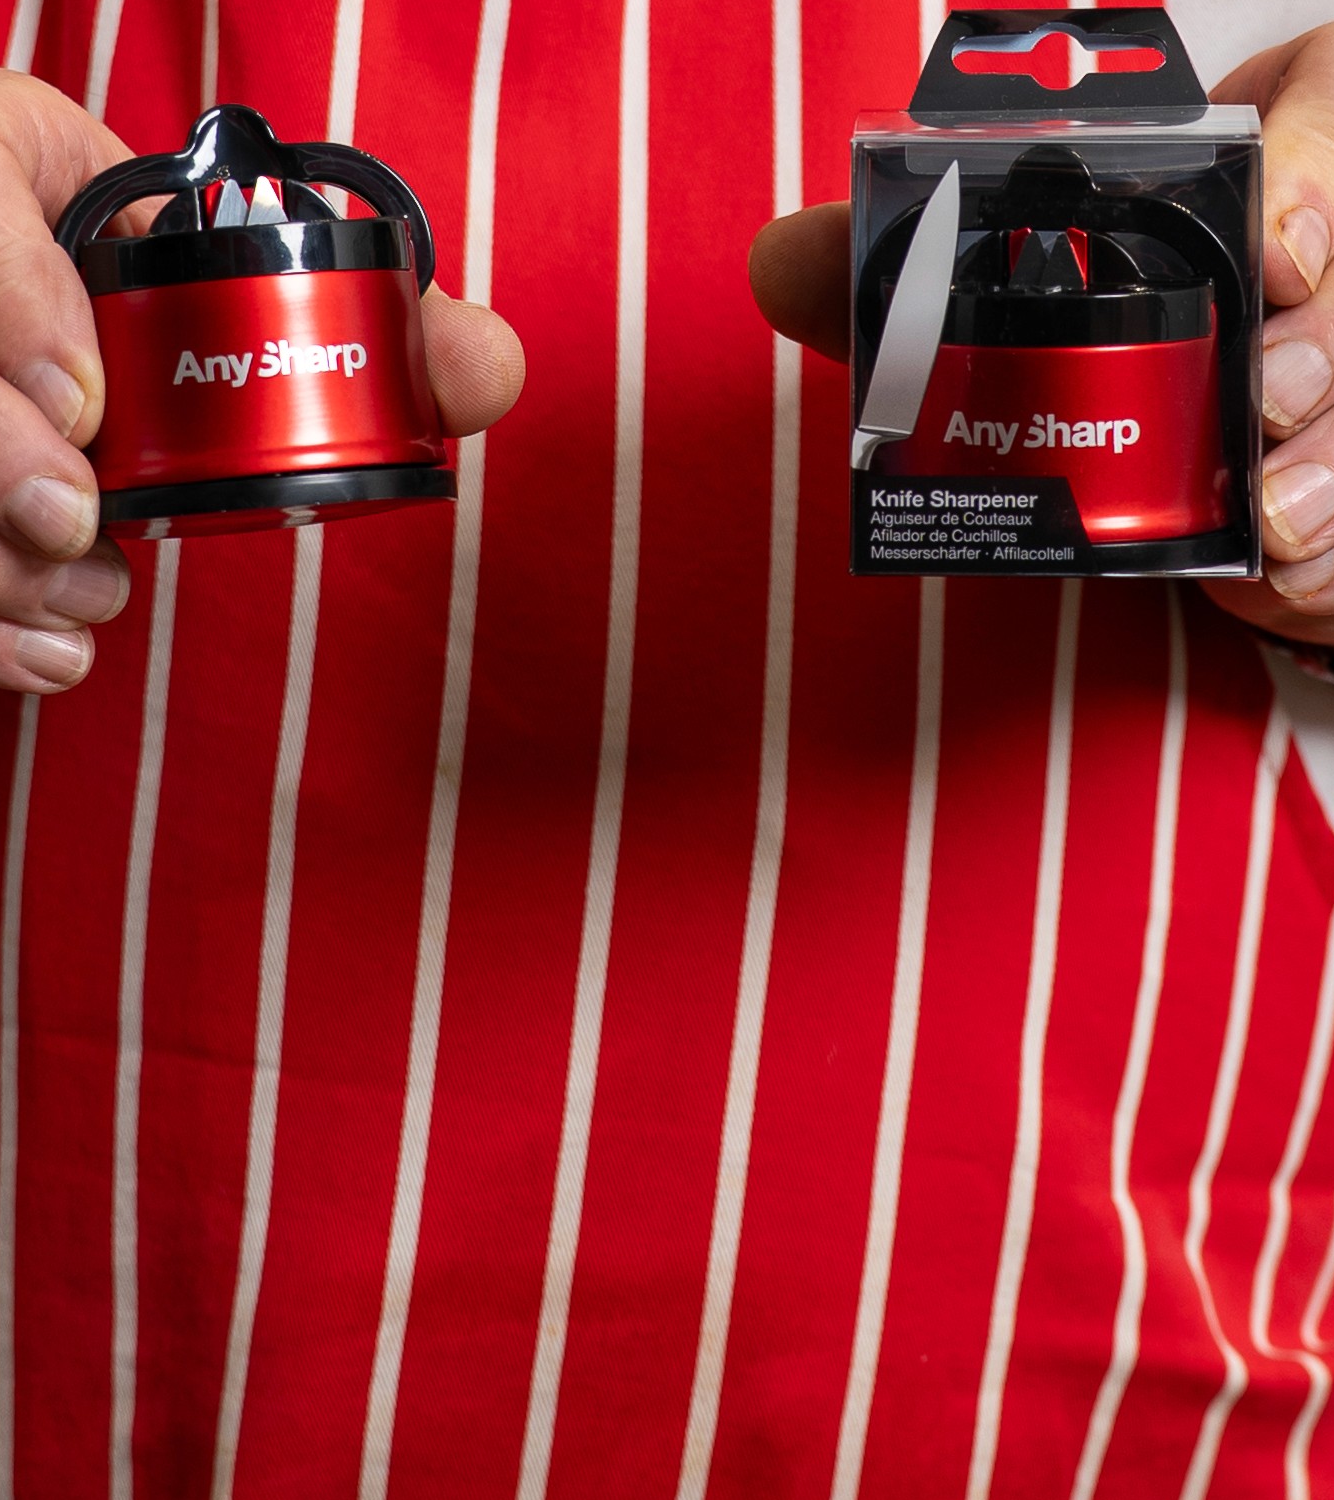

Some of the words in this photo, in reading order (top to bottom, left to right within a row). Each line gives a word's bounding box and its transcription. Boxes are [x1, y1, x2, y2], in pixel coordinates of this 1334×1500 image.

[173, 350, 253, 388] Any
[257, 339, 367, 378] Sharp
[943, 410, 1019, 455] Any
[1023, 413, 1141, 454] Sharp
[871, 490, 924, 508] Knife
[930, 490, 1039, 511] Sharpener
[870, 511, 936, 528] Aiguiseur
[940, 512, 959, 525] de
[963, 512, 1033, 526] Couteaux
[870, 529, 925, 542] Afilador
[929, 529, 948, 542] de
[951, 529, 1018, 542] Cuchillos
[870, 546, 981, 560] Messerschärfer
[993, 547, 1075, 561] Affilacoltelli
